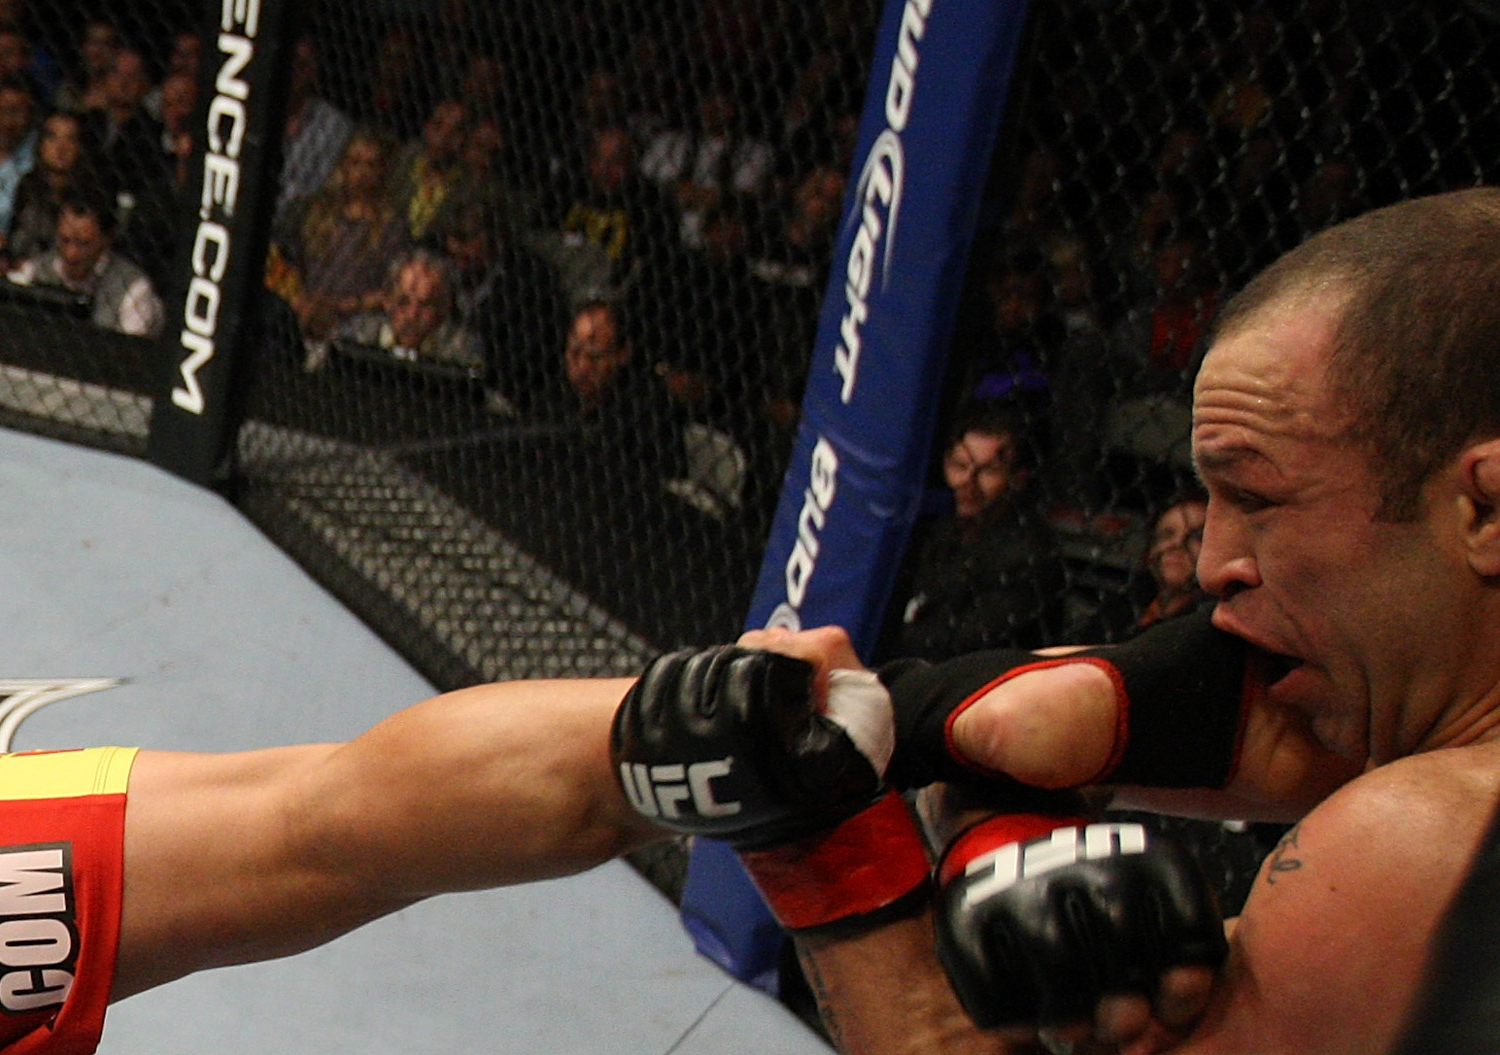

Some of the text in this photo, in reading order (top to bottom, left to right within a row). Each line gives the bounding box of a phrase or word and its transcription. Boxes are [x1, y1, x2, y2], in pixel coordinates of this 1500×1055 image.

[885, 0, 932, 133] UD
[786, 437, 838, 609] BUD
[619, 760, 742, 819] UFC
[962, 823, 1146, 909] UFC
